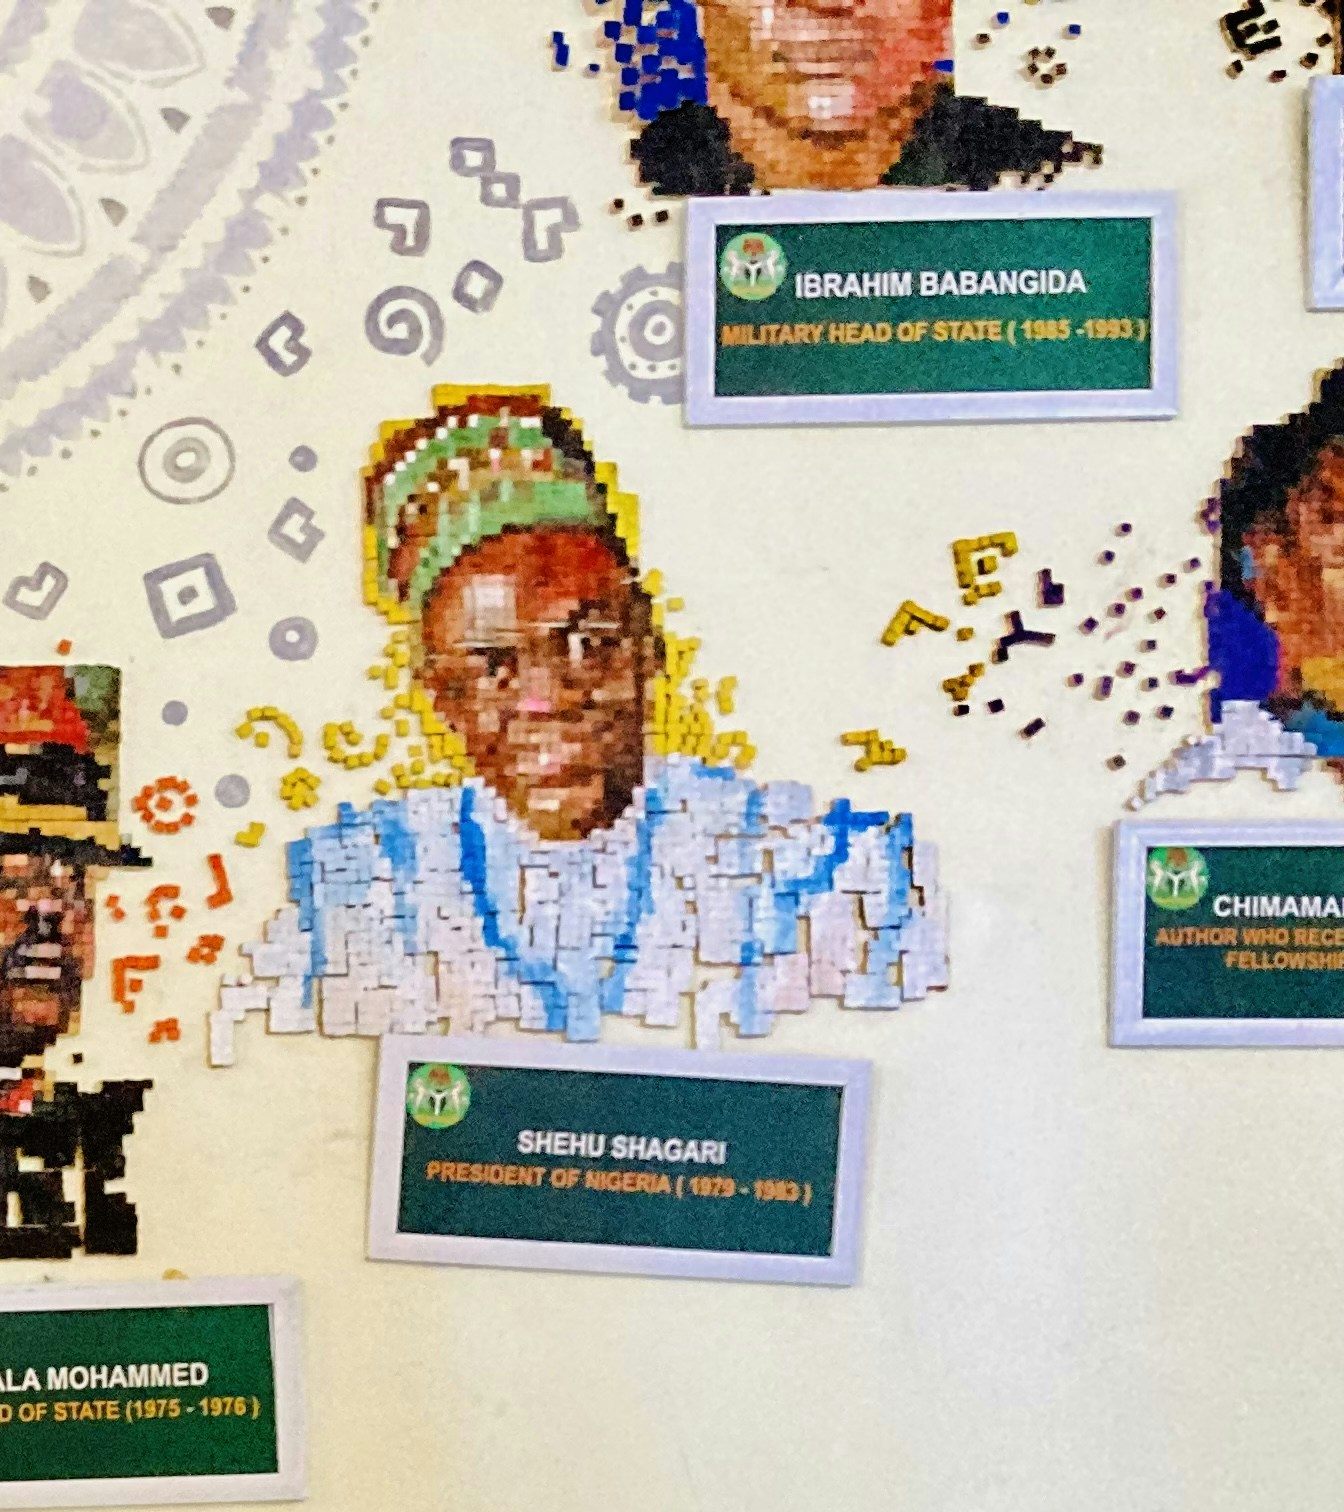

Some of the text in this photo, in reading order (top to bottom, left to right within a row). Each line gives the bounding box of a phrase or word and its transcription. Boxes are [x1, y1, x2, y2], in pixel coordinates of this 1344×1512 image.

[795, 268, 1088, 299] IBRAHIM BABANGIDA
[721, 323, 823, 346] MILITARY
[828, 322, 892, 344] HEAD
[896, 321, 929, 343] OF
[931, 320, 1002, 342] STATE
[1213, 894, 1344, 918] CHIMAMA
[1156, 927, 1237, 945] AUTHOR
[1242, 927, 1289, 945] WHO
[517, 1129, 728, 1165] SHEHU SHAGARI
[425, 1160, 547, 1186] PRESIDENT
[550, 1168, 582, 1189] OF
[584, 1169, 672, 1195] NIGERIA
[47, 1362, 209, 1391] MOHAMMED
[18, 1402, 48, 1422] OF
[53, 1400, 120, 1422] STATE
